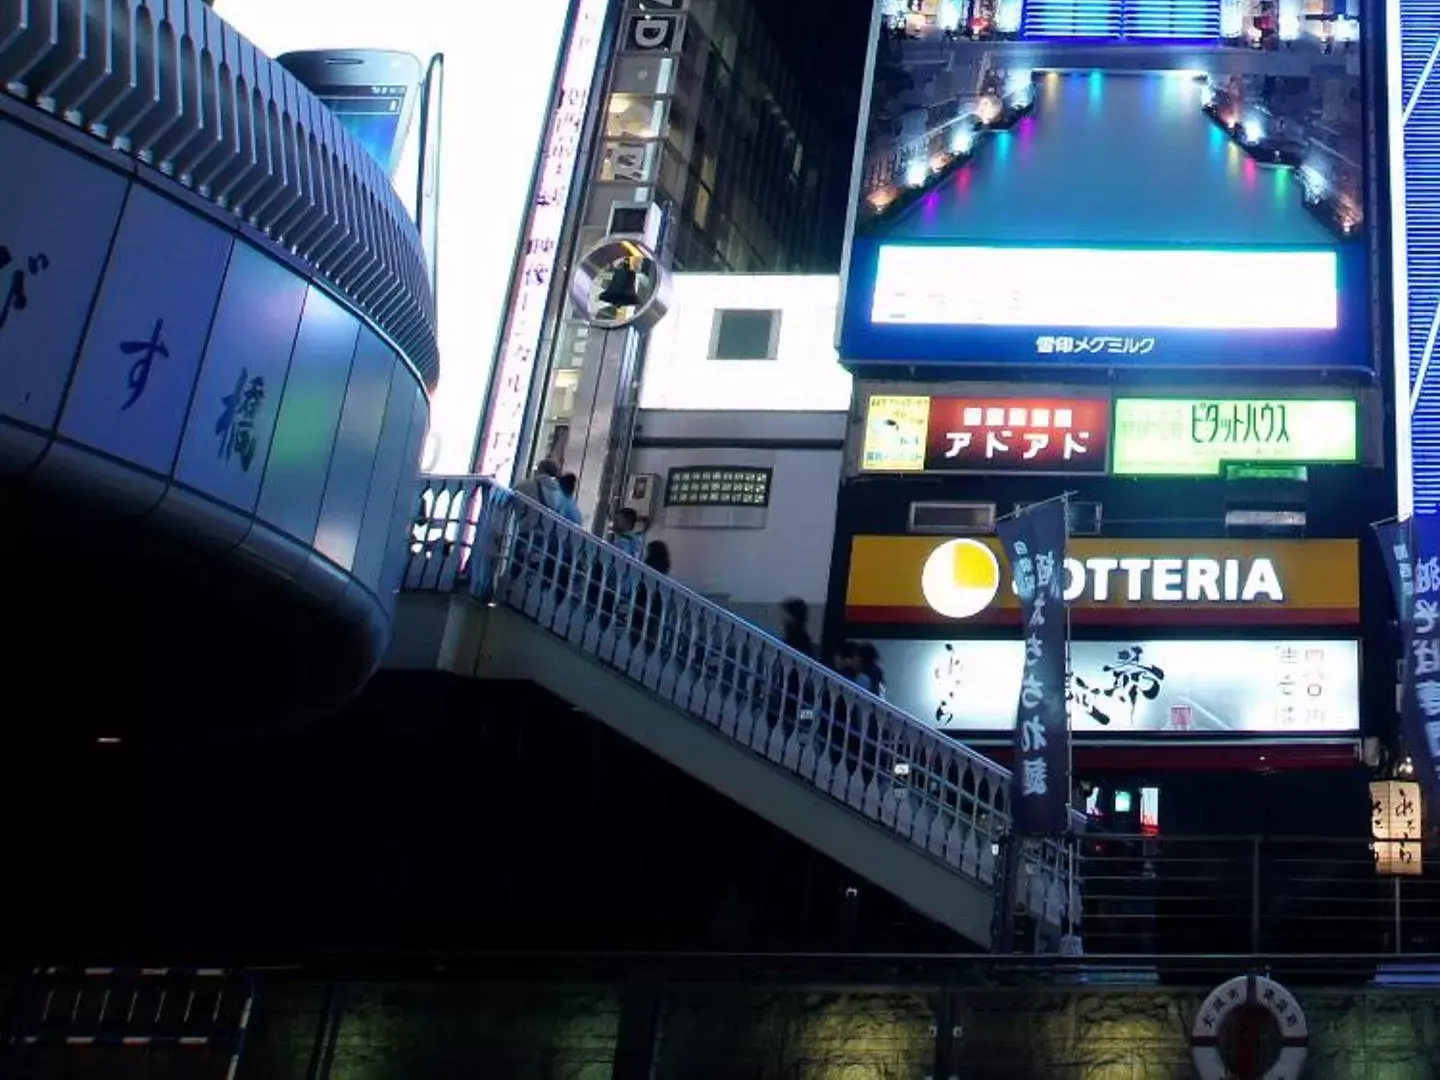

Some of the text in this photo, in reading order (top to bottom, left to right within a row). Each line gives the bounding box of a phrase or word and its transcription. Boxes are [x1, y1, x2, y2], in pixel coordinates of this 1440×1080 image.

[1035, 335, 1155, 354] 雪印メグミルク
[945, 431, 1091, 461] アドアド
